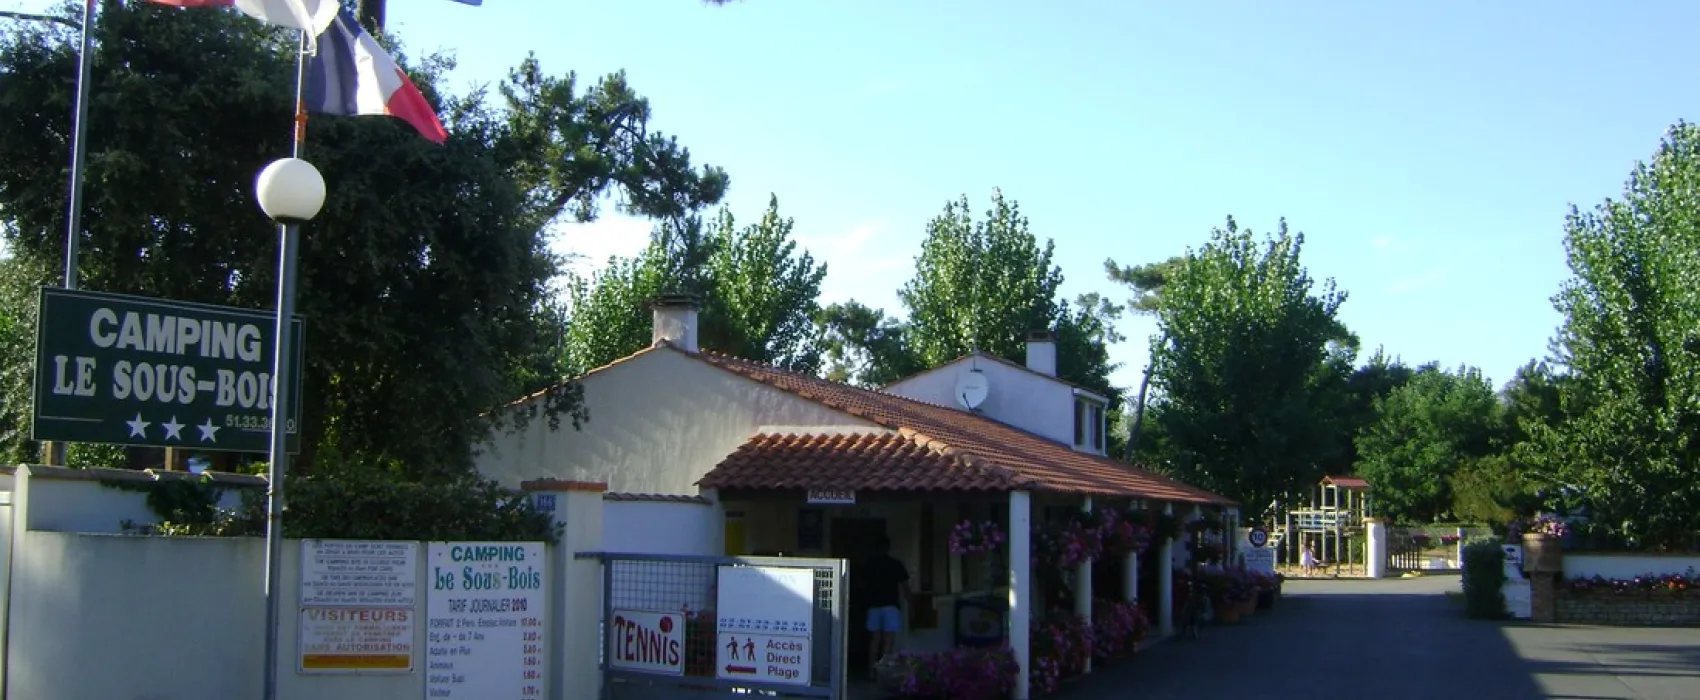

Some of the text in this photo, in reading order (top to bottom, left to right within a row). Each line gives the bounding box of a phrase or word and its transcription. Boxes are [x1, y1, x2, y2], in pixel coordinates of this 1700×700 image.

[89, 308, 262, 362] CAMPING
[53, 355, 97, 397] LE
[809, 488, 854, 501] ACCUEIL
[450, 545, 525, 562] CAMPING
[434, 565, 541, 590] Le Sous-Bois
[448, 597, 528, 613] TARIF JOURNALIER 2010
[308, 610, 408, 621] VISITEURS
[336, 643, 411, 652] AUTORISATION
[614, 616, 680, 666] TENNIS
[766, 638, 803, 651] Accès
[766, 652, 801, 665] Direct
[767, 665, 800, 679] Plage
